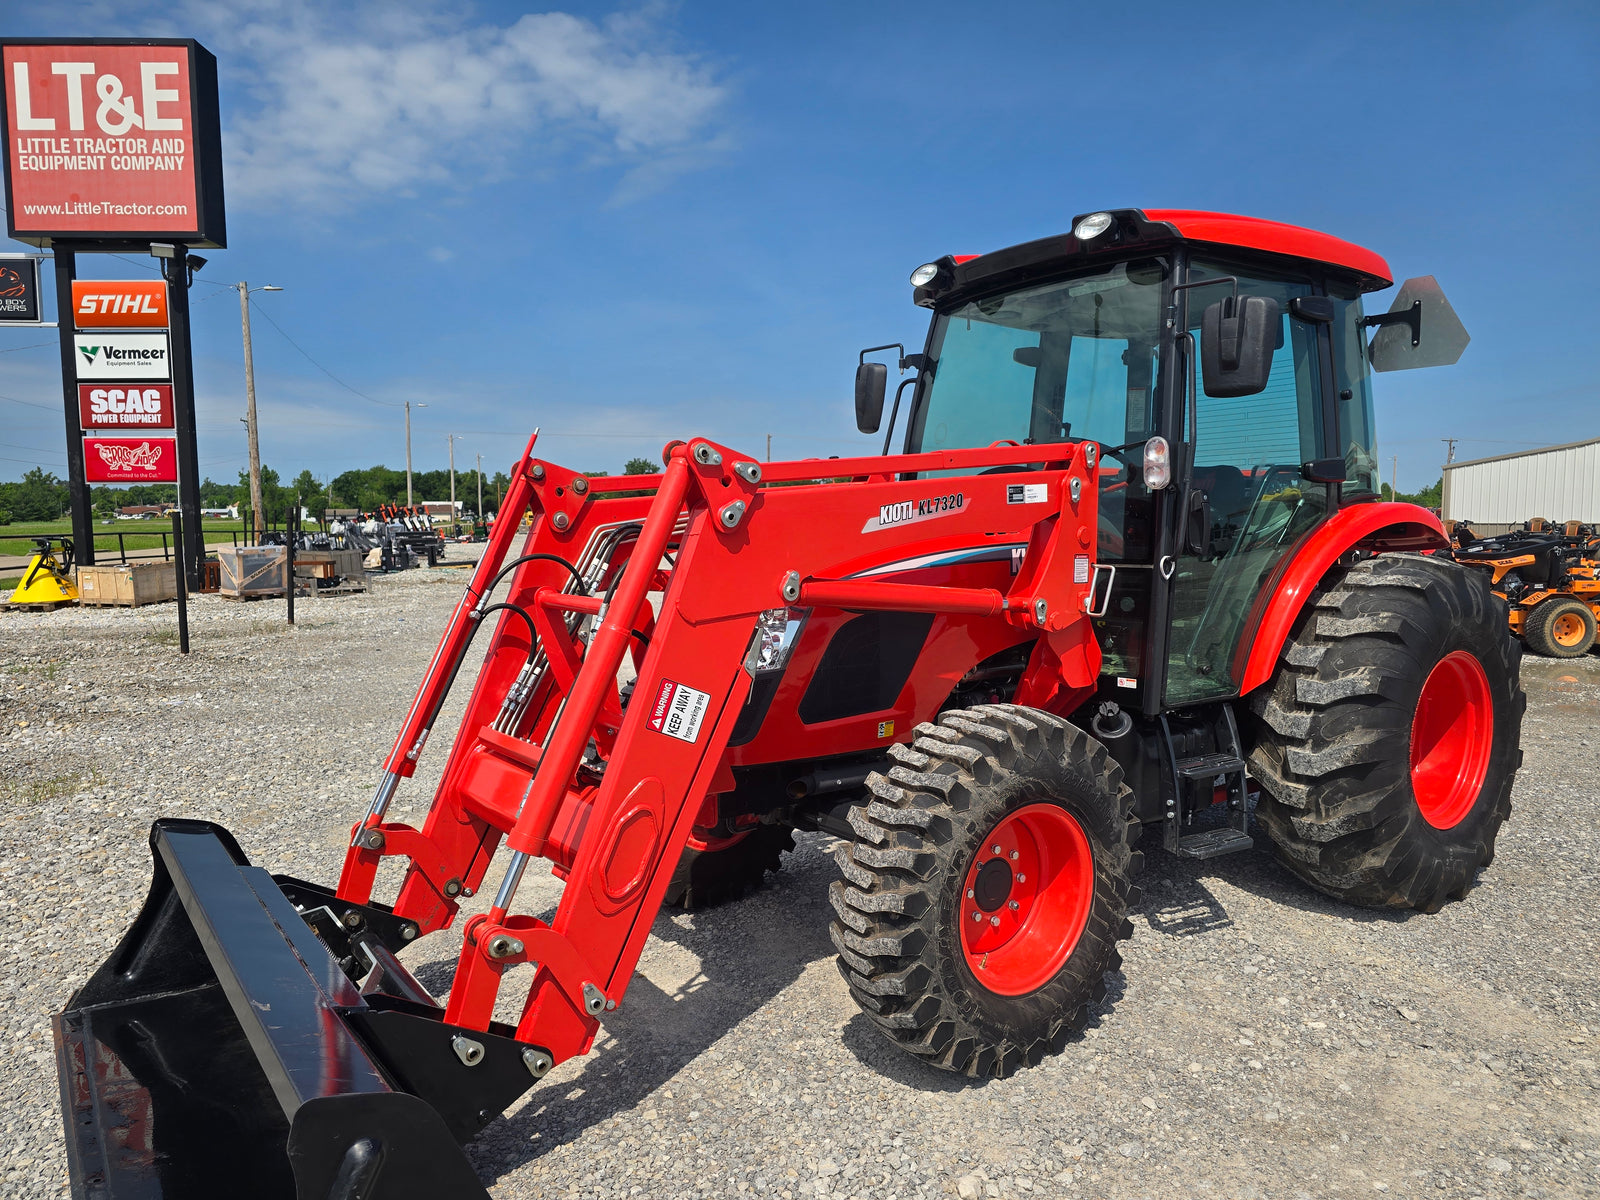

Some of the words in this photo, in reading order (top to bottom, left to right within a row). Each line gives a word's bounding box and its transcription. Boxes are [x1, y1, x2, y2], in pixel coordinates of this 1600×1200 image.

[13, 62, 183, 136] LT&E
[17, 138, 70, 154] LITTLE
[74, 138, 147, 154] TRACTOR
[152, 138, 185, 154] AND
[19, 155, 106, 171] EQUIPMENT
[111, 155, 184, 171] COMPANY
[24, 202, 188, 215] www.LittleTractor.com
[78, 294, 159, 314] STIHL
[102, 345, 165, 360] Vermeer
[90, 389, 162, 414] SCAG
[91, 413, 118, 424] POWER
[119, 413, 162, 424] EQUIPMENT
[880, 500, 913, 525] KIOTI
[918, 493, 964, 516] KL7320
[654, 682, 673, 717] WARNING
[674, 688, 692, 714] AWAY
[667, 713, 683, 736] KEEP
[682, 725, 694, 739] from
[688, 705, 702, 727] working
[695, 694, 705, 706] area
